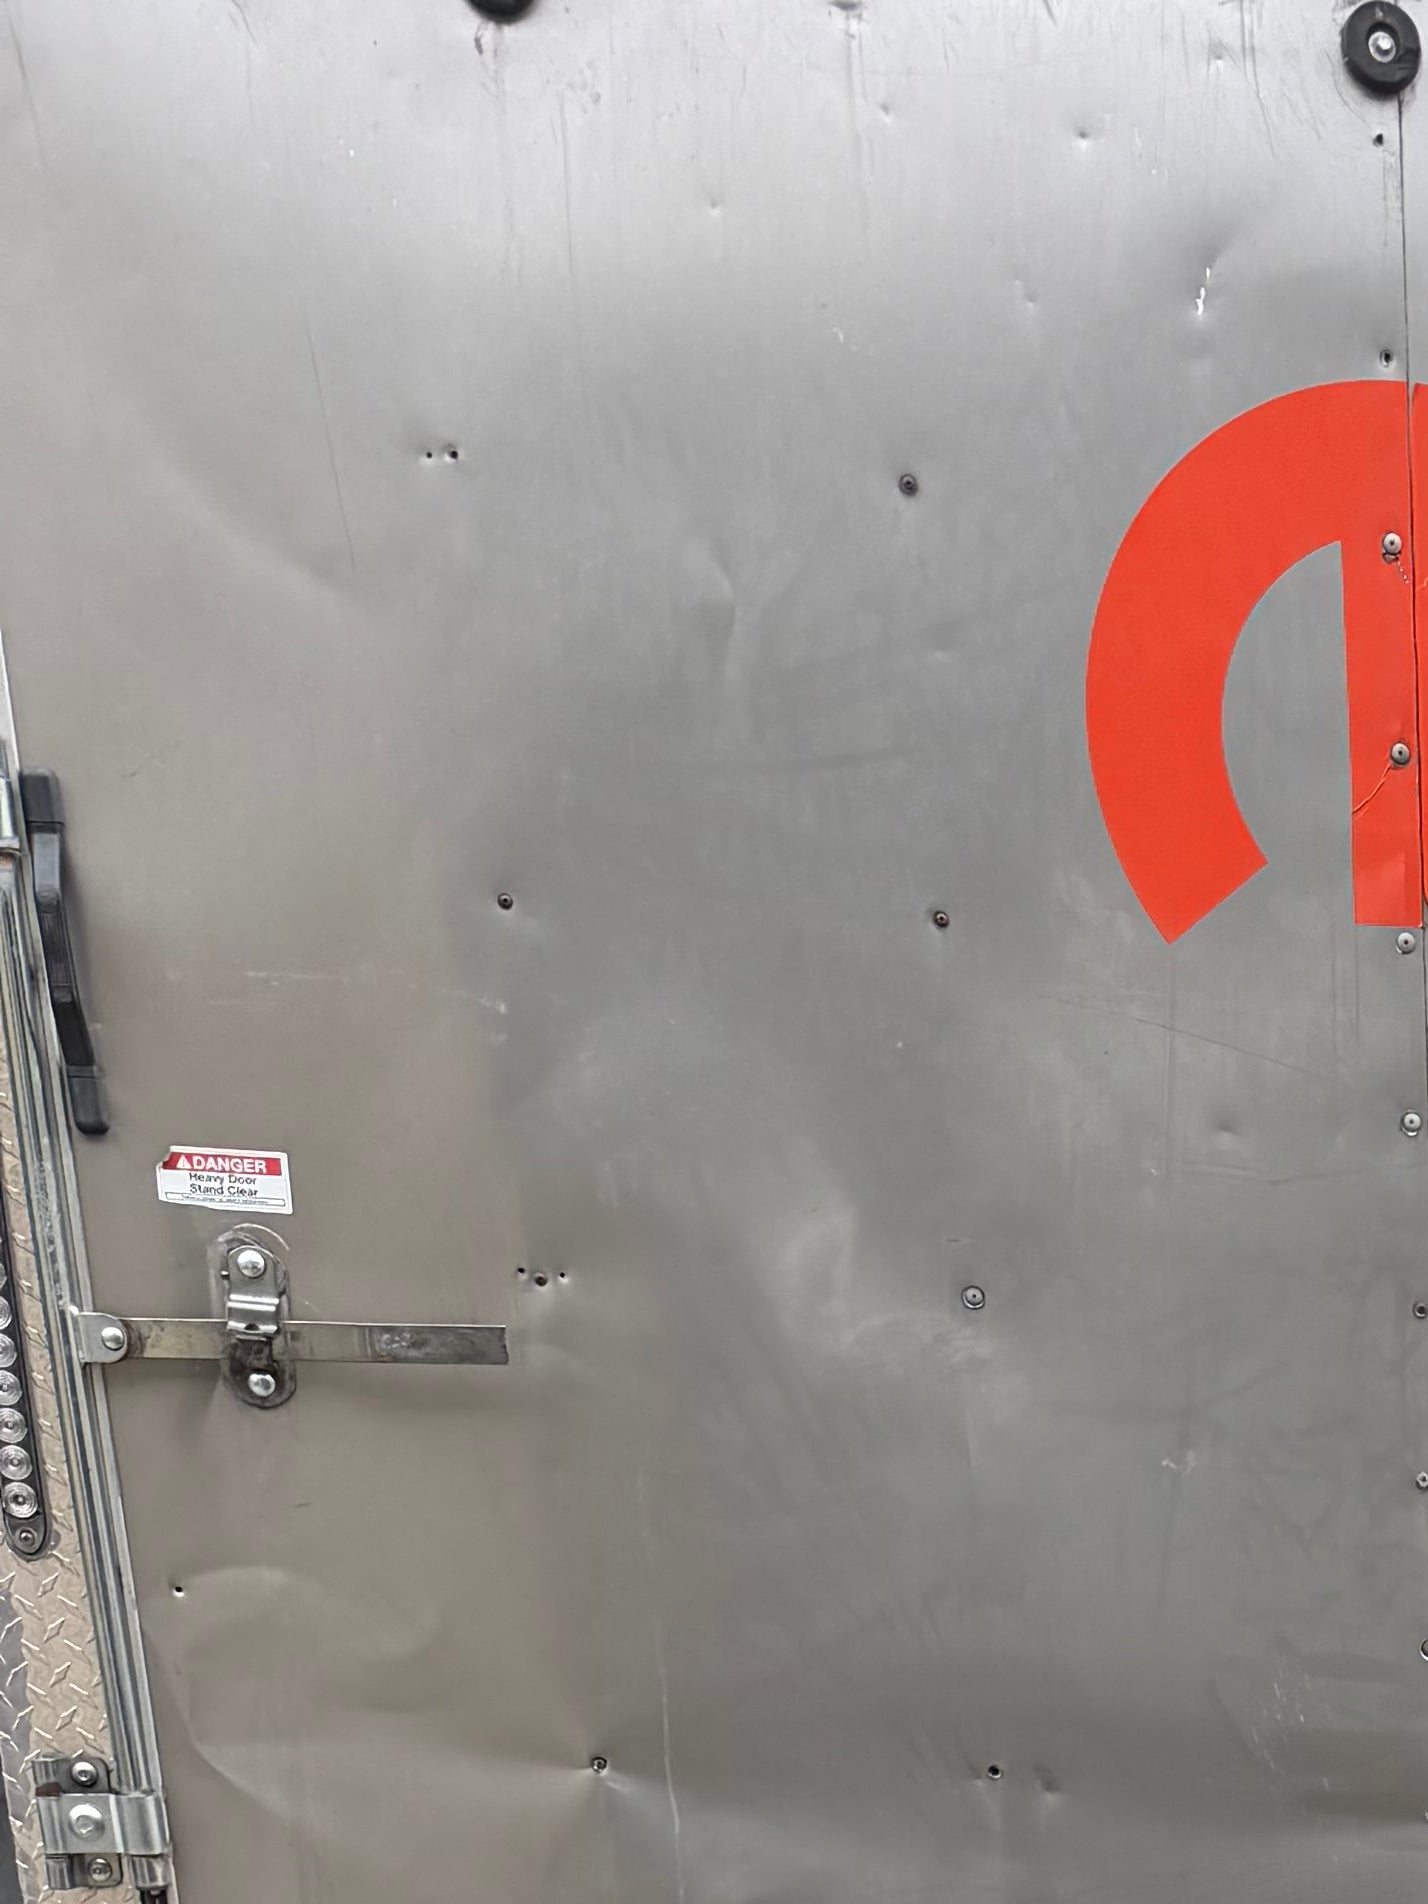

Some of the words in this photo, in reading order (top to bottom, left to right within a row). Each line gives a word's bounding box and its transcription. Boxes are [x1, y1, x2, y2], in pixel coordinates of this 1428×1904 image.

[192, 1155, 267, 1174] DANGER
[189, 1173, 224, 1185] Heavy
[228, 1174, 257, 1185] Door
[190, 1184, 224, 1195] Stand
[227, 1185, 258, 1197] Clear
